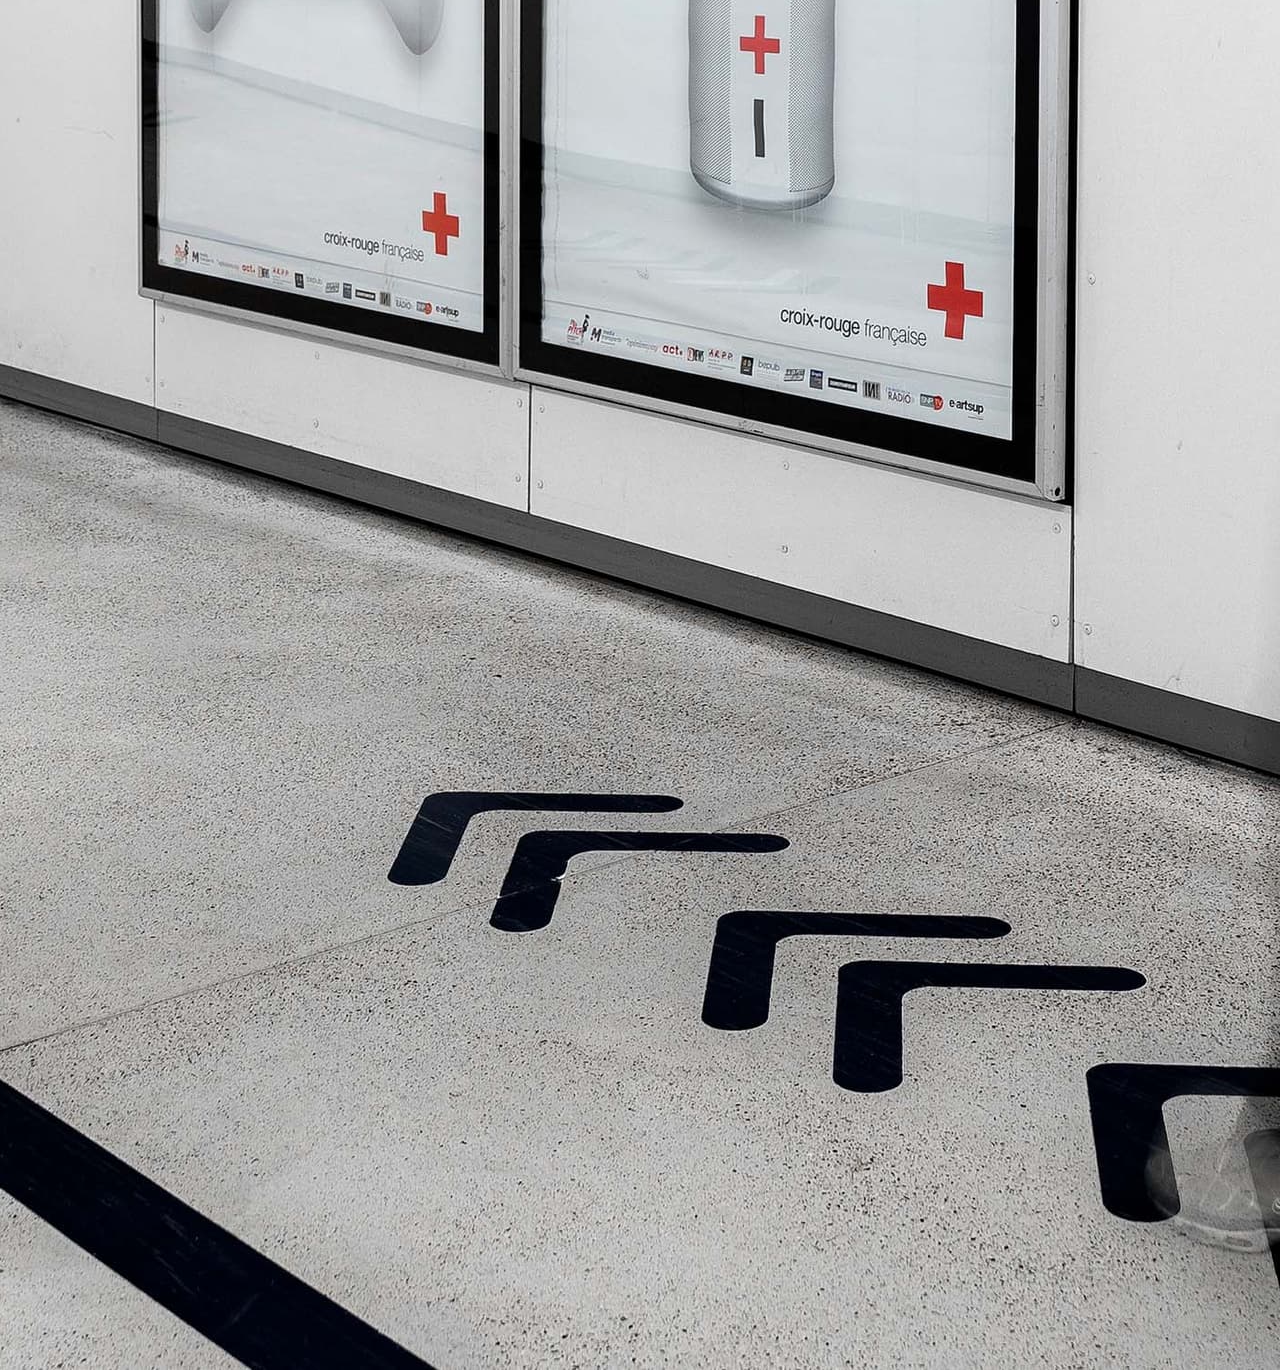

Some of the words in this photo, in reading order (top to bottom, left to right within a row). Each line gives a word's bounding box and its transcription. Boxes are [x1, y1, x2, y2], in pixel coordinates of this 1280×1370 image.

[324, 231, 380, 256] croix-rouge
[381, 239, 425, 262] française
[780, 308, 860, 338] croix-rouge
[863, 318, 927, 347] française
